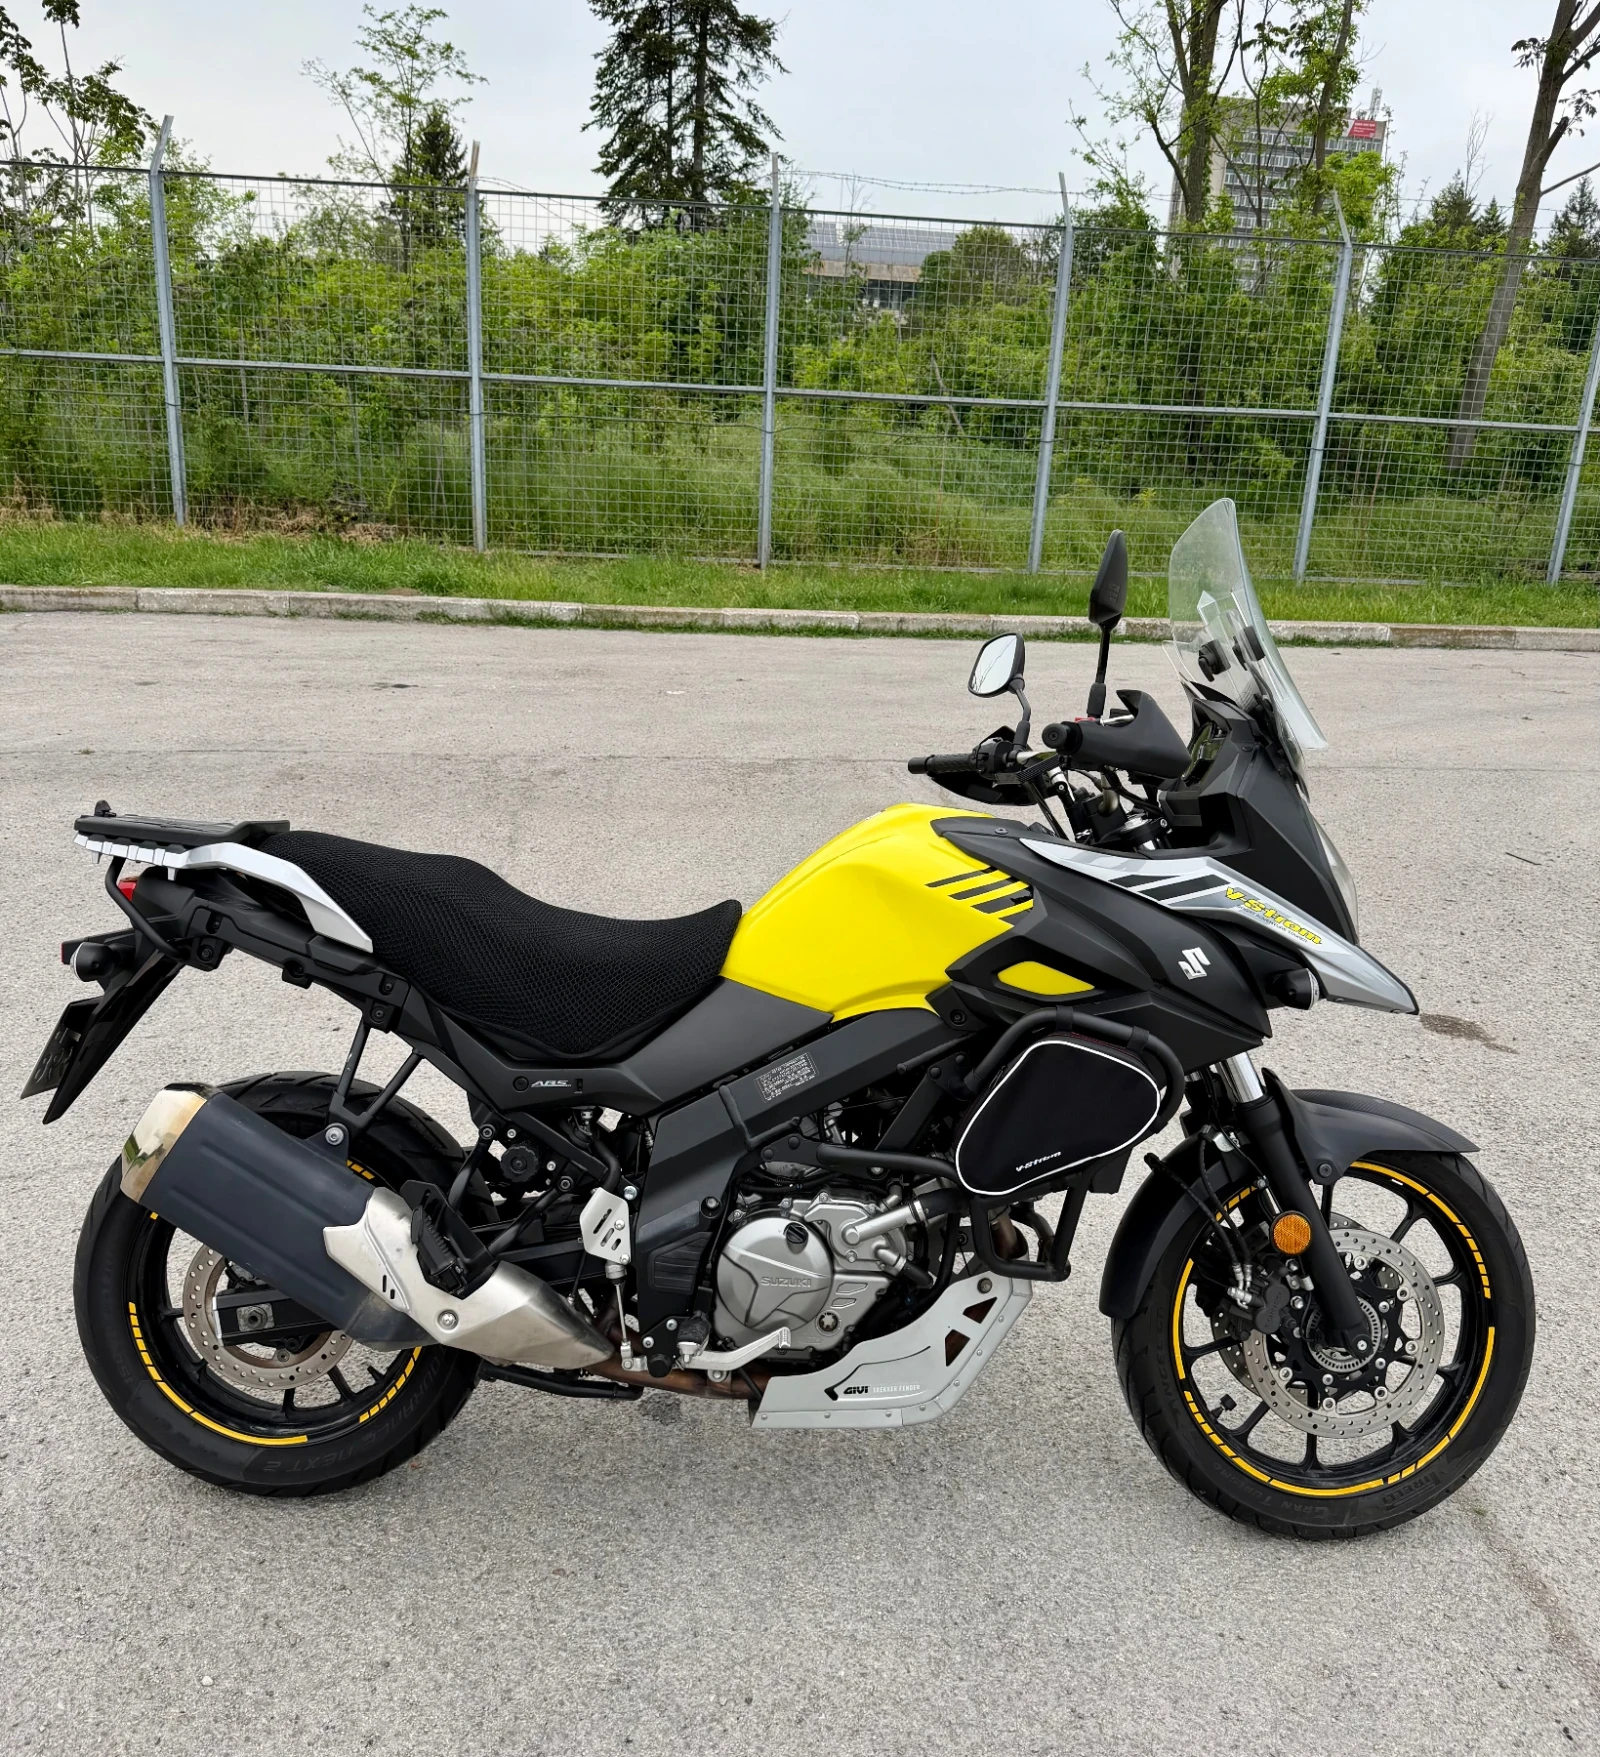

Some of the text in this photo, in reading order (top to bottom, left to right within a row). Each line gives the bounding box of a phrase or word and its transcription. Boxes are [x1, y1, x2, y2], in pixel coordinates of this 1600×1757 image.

[1226, 886, 1322, 945] V-Strom
[531, 1079, 571, 1088] ABS
[760, 1276, 812, 1288] SUZUKI
[843, 1384, 921, 1395] GIVI TREKKER FENDER
